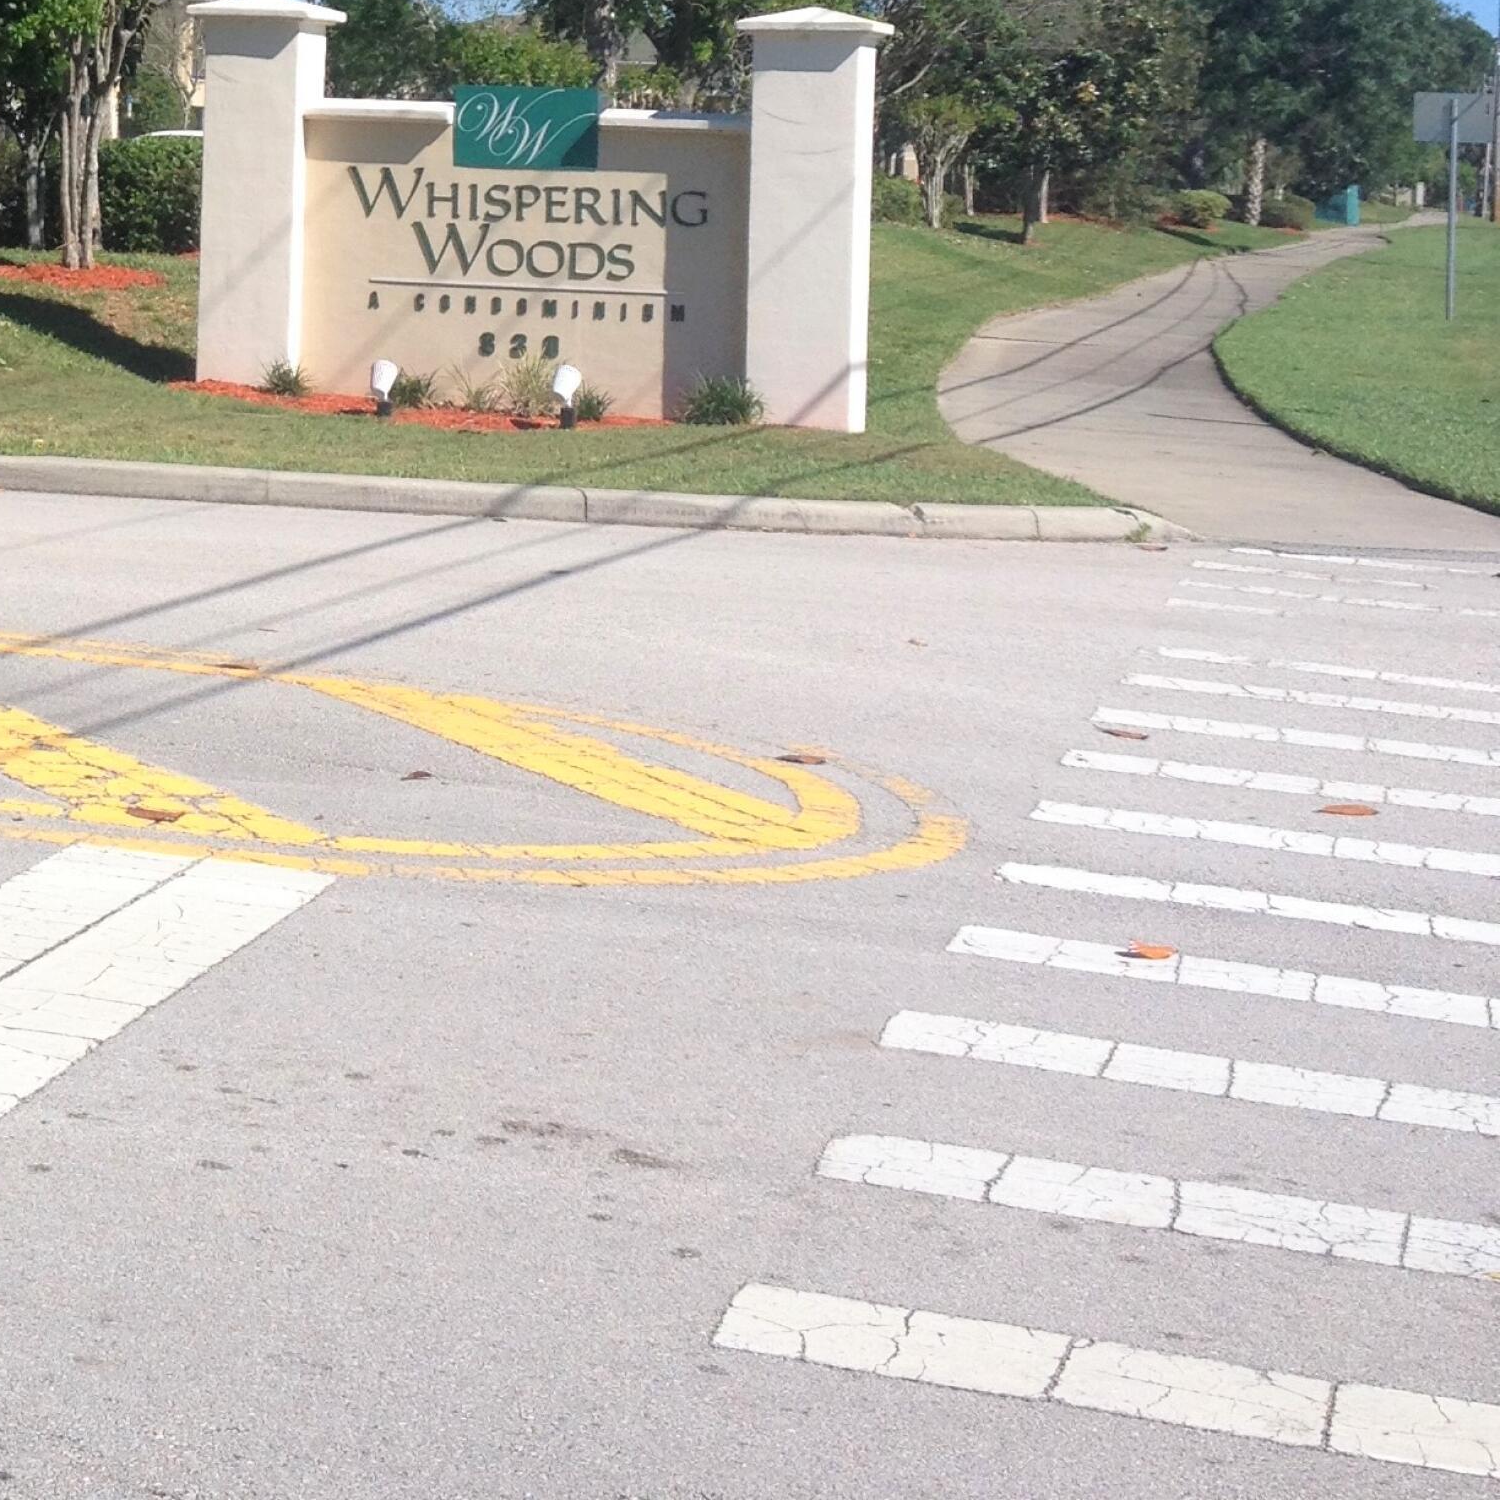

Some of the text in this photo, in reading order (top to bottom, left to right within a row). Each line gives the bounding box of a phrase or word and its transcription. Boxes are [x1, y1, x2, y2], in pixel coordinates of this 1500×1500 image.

[347, 165, 709, 228] WHISPERING
[411, 220, 636, 281] WOODS
[367, 290, 685, 322] A CONDOMINIUM
